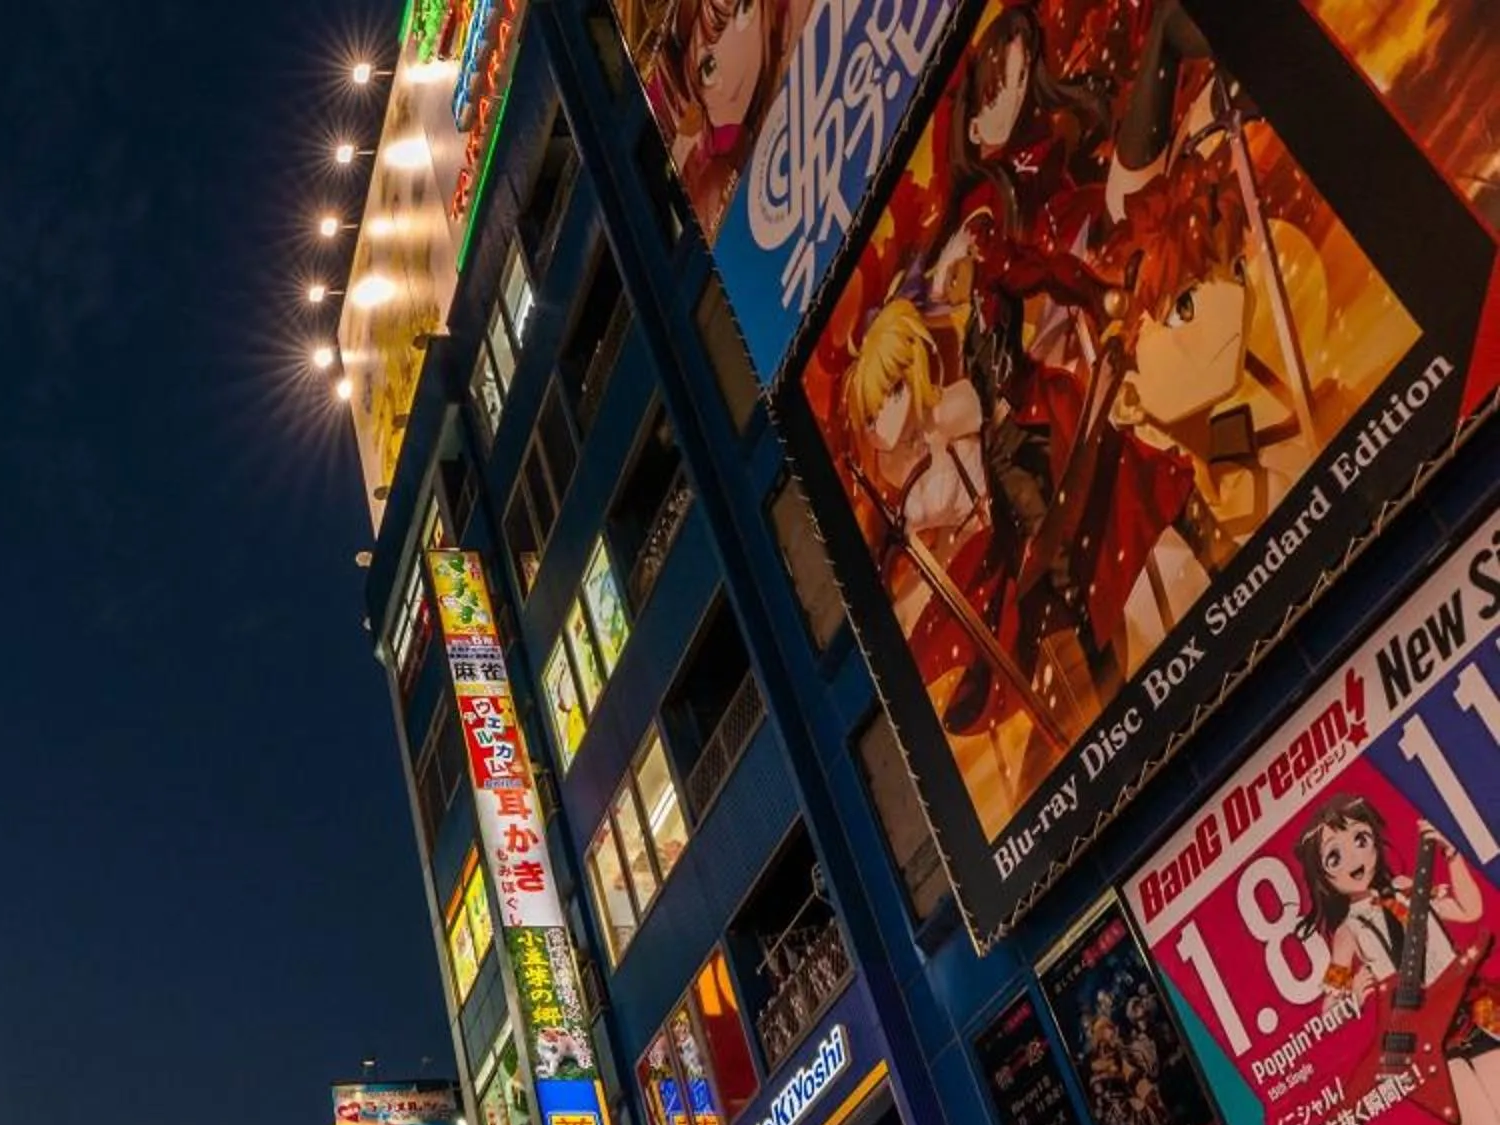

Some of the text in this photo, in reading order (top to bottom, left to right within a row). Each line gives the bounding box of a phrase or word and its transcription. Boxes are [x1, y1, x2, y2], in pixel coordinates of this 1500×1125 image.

[993, 353, 1457, 882] Blu-ray Disc Box Standard Edition
[1375, 587, 1469, 712] New
[497, 788, 545, 894] 耳かき
